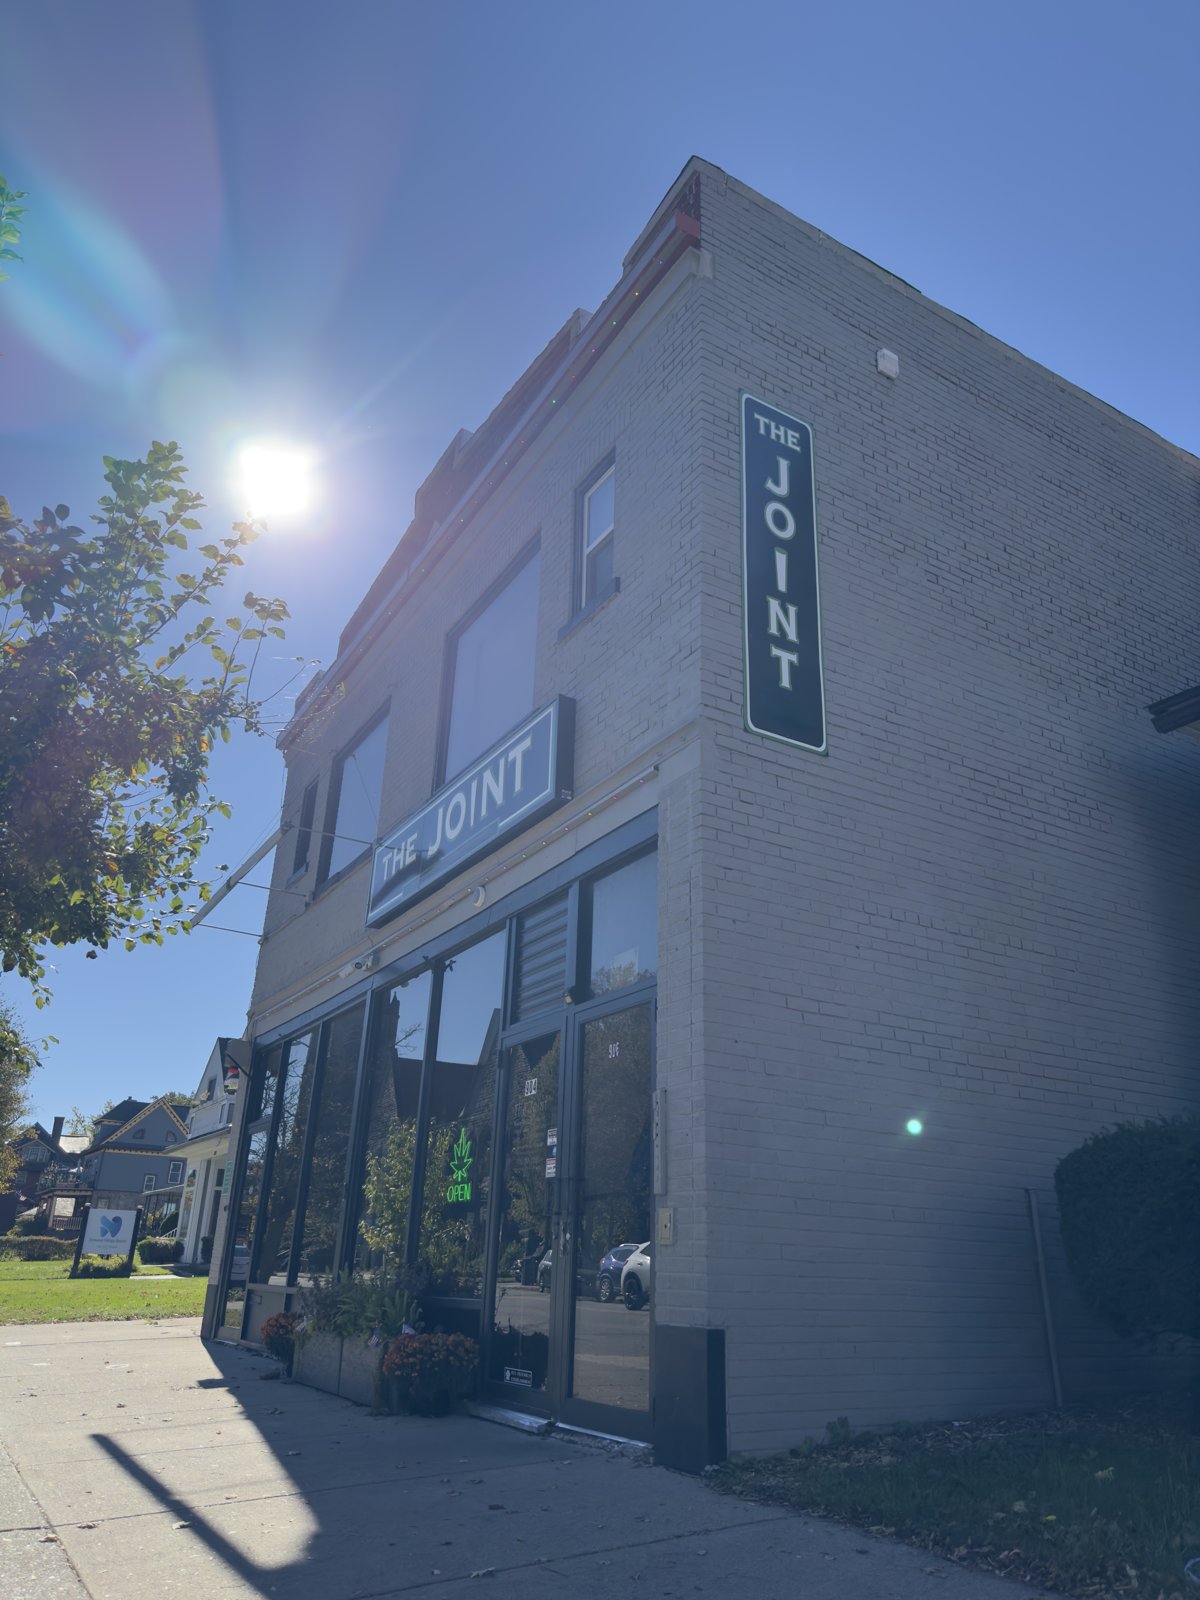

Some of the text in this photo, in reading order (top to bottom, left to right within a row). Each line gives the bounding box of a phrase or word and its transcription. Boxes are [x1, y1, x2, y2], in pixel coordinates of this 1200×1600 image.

[754, 412, 801, 452] THE
[765, 455, 799, 691] JOINT
[382, 736, 532, 881] THE JOINT
[446, 1183, 471, 1202] OPEN
